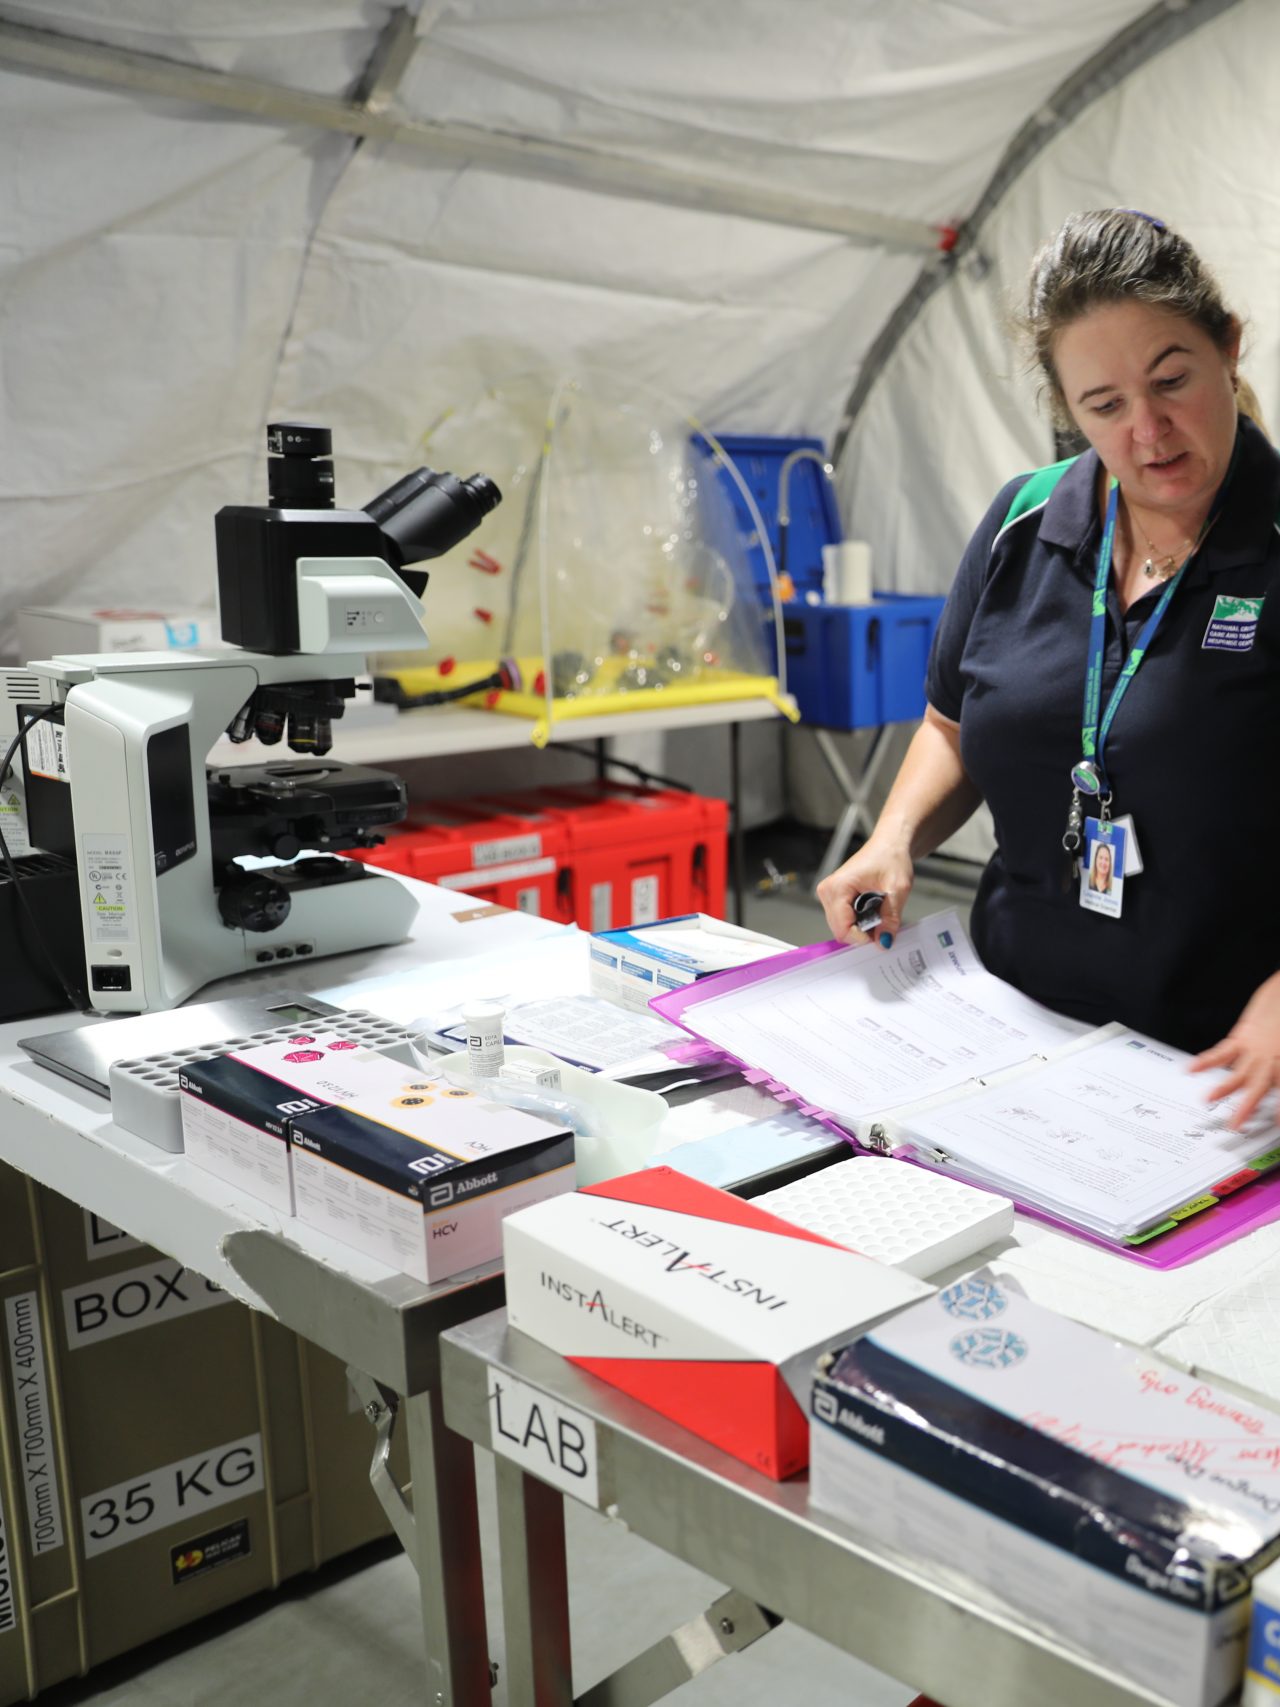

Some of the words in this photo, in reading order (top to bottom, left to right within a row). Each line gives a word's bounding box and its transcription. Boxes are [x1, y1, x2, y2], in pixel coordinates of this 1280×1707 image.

[456, 1172, 498, 1194] Abbott
[432, 1222, 458, 1240] HCV
[14, 1299, 35, 1368] 400mm
[74, 1267, 189, 1334] BOX
[18, 1372, 38, 1390] X
[24, 1391, 45, 1463] 700mm
[495, 1382, 588, 1478] LAB
[839, 1408, 885, 1445] Abbott
[28, 1463, 48, 1482] X
[88, 1482, 155, 1540] 35
[175, 1447, 256, 1507] KG
[34, 1482, 56, 1552] 700mm
